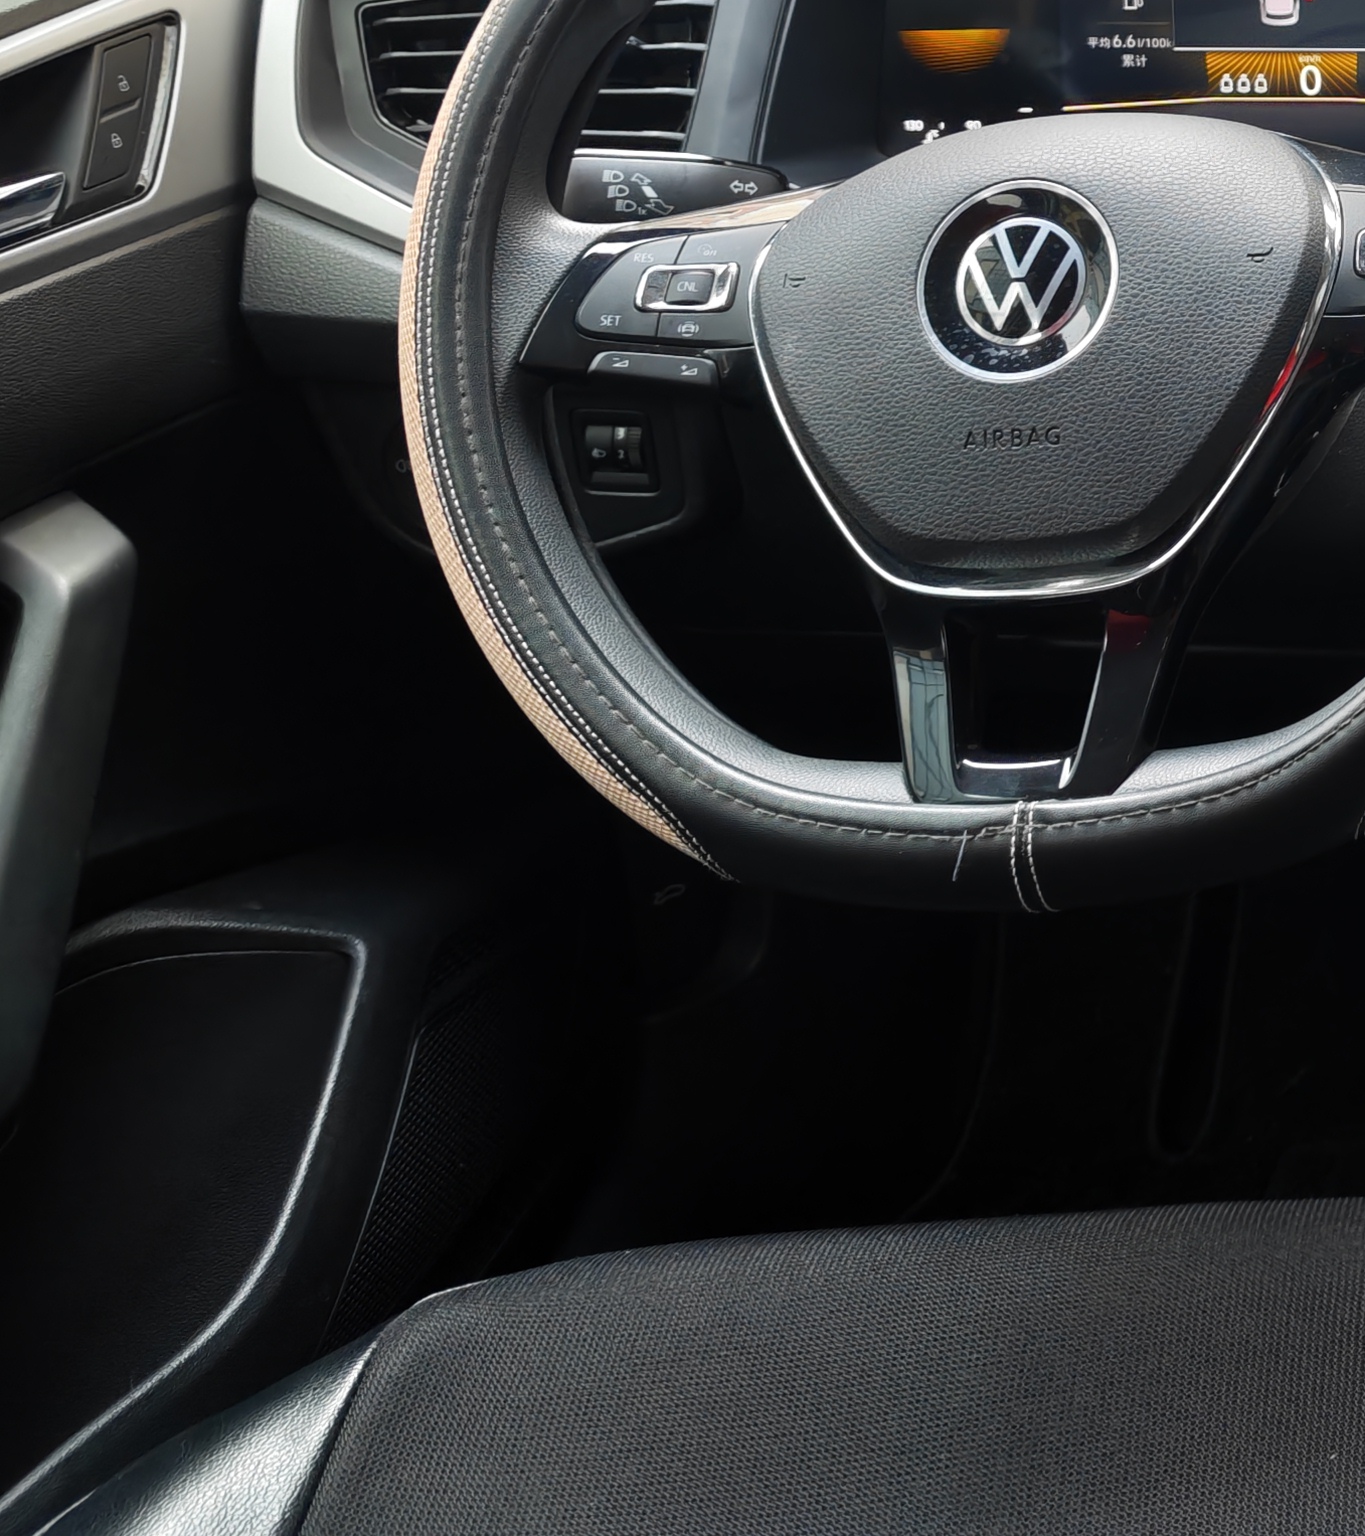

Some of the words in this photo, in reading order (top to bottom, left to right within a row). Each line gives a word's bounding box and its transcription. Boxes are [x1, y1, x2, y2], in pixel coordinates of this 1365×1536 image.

[1121, 53, 1148, 67] 累计
[1300, 64, 1322, 96] 0
[633, 252, 654, 263] RES
[677, 281, 699, 292] CNL
[600, 315, 622, 326] SET
[963, 426, 1061, 450] AIRBAG
